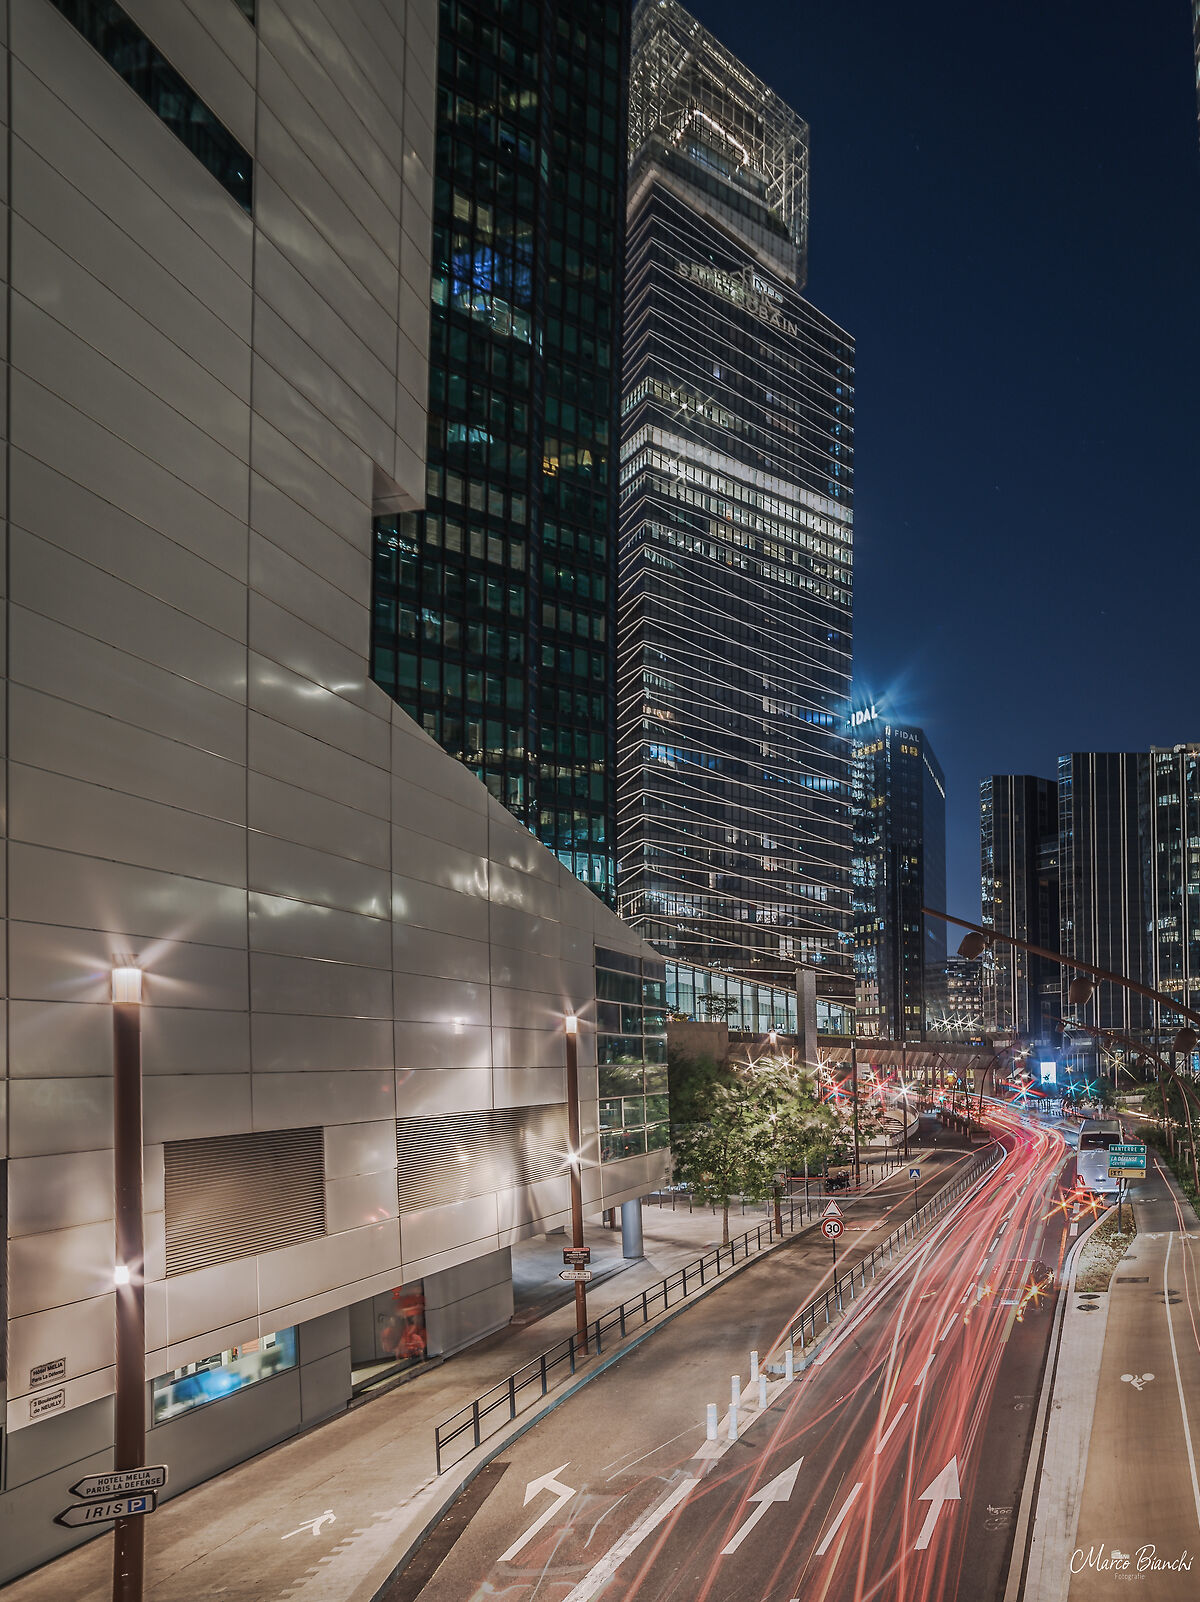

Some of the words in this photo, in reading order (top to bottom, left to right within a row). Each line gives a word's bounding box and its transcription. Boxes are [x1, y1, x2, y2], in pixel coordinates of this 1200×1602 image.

[845, 705, 878, 728] IDAL
[894, 729, 920, 743] FIDAL
[826, 1223, 840, 1234] 30
[47, 1362, 63, 1370] MELIA
[37, 1393, 62, 1405] Boulevard
[41, 1400, 62, 1411] NEUILLY
[98, 1476, 123, 1485] HOTEL
[126, 1472, 150, 1481] MELIA
[86, 1485, 110, 1494] PARIS
[113, 1482, 122, 1490] LA
[125, 1477, 161, 1488] DEFENSE
[85, 1503, 123, 1519] IRIS
[130, 1500, 143, 1512] P
